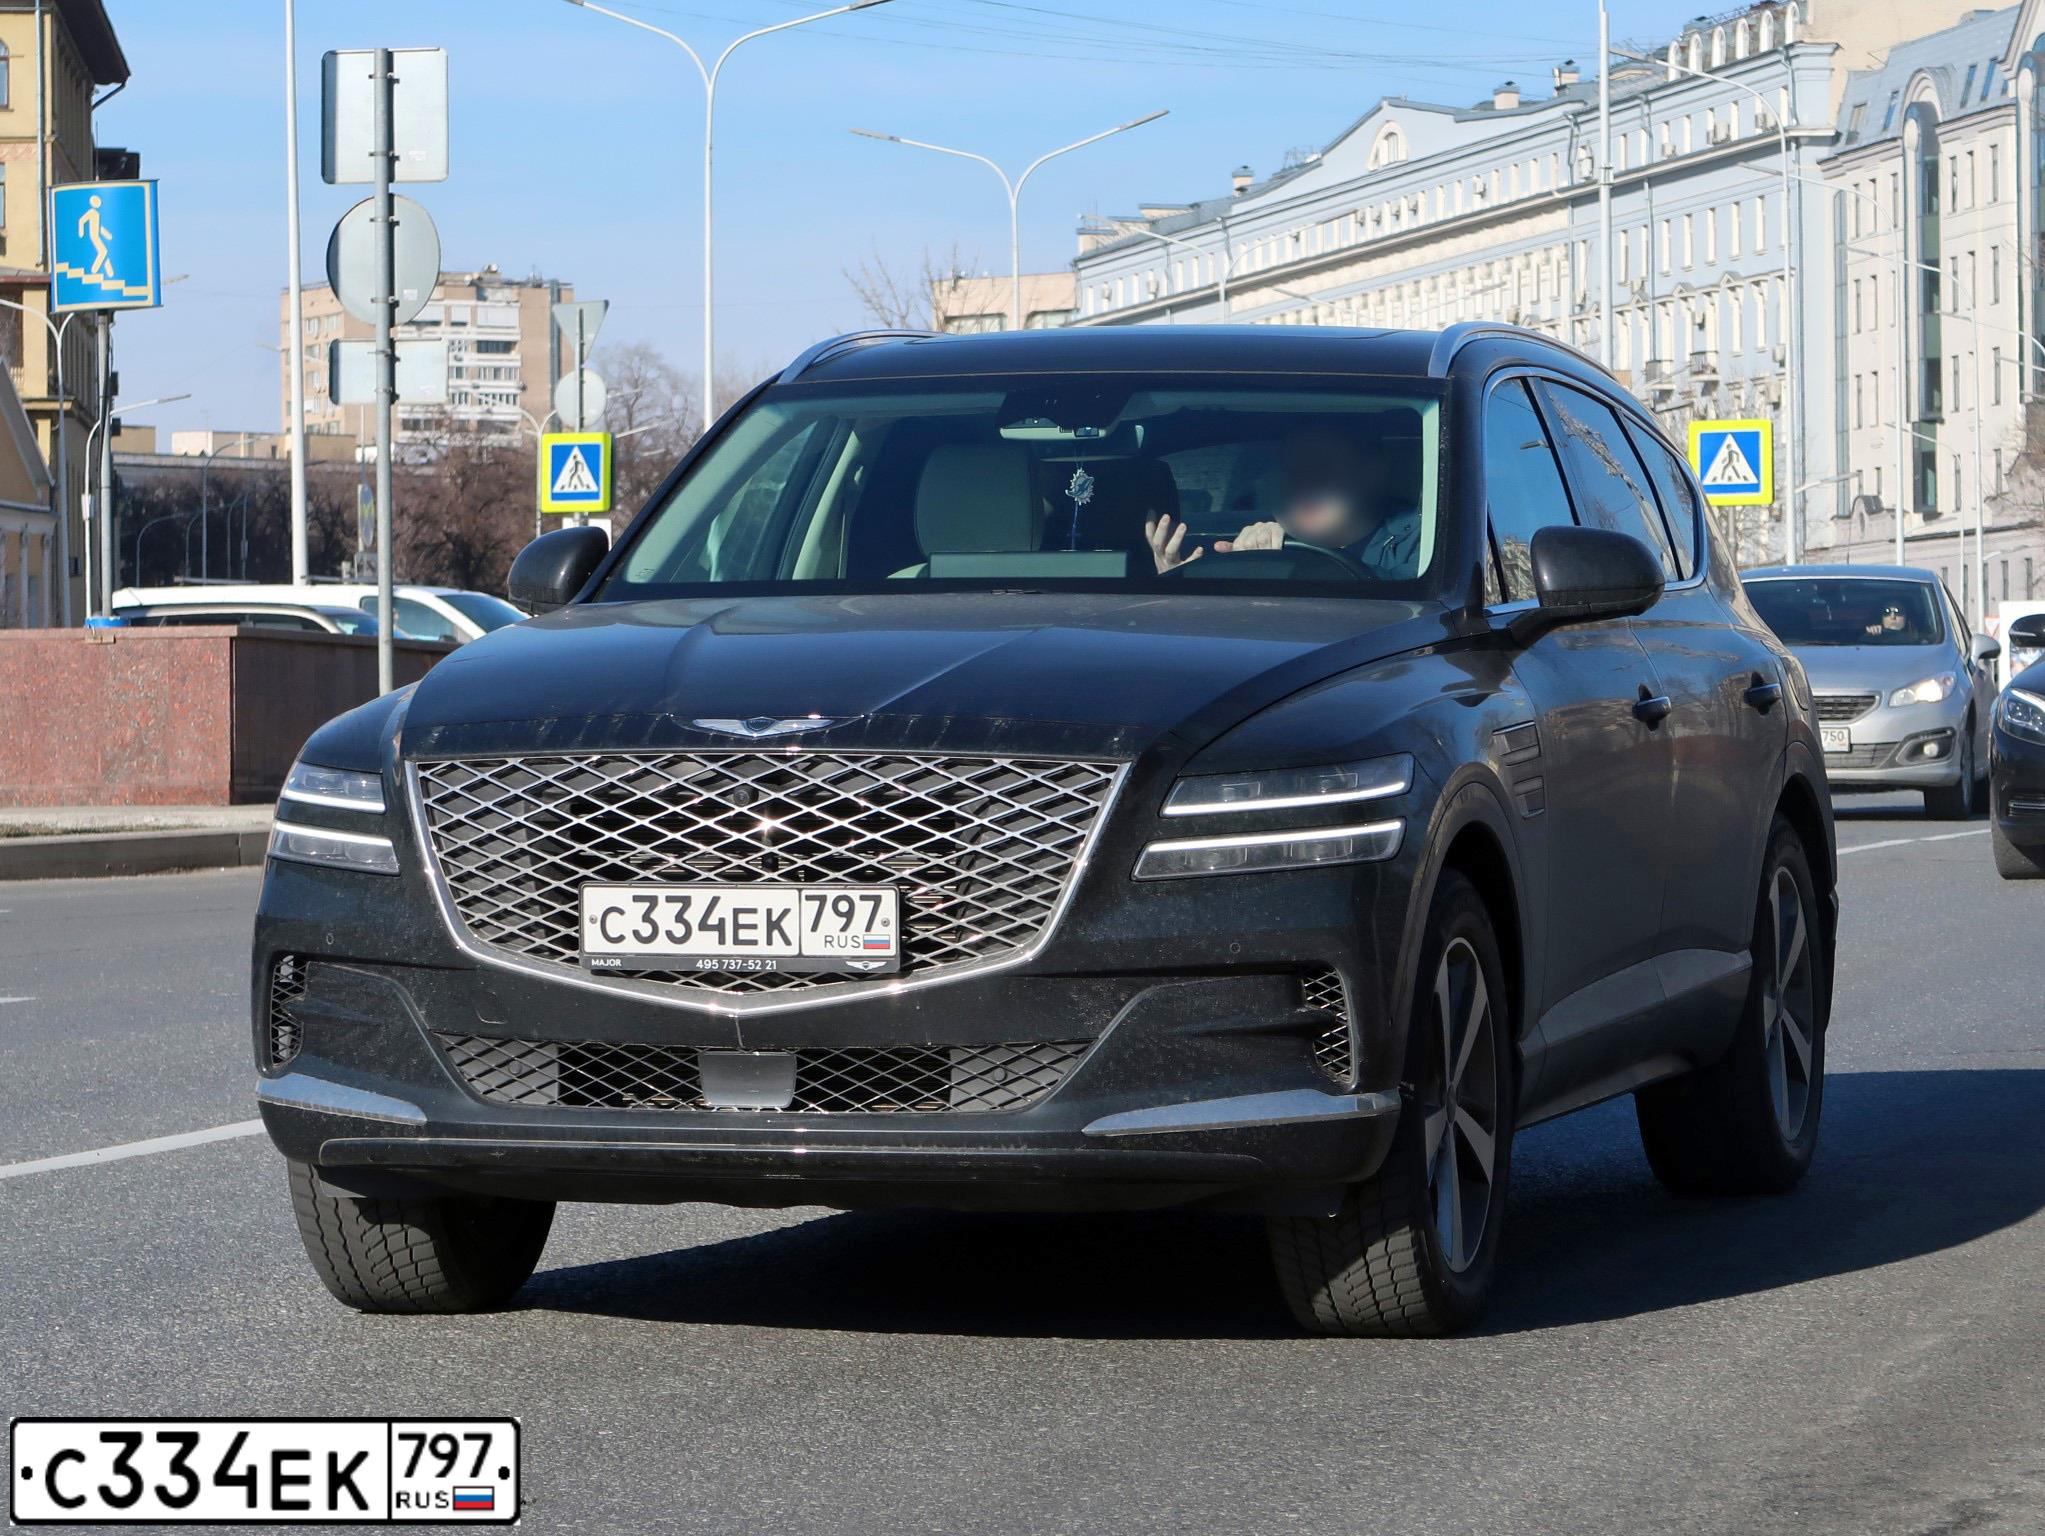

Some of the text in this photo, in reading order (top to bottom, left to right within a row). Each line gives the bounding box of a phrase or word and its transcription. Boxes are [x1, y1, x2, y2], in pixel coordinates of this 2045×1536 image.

[1822, 730, 1845, 742] 750
[804, 894, 882, 933] 797
[824, 934, 861, 949] RUS
[591, 958, 622, 967] MAJOR
[695, 959, 777, 971] 495 737-52 21
